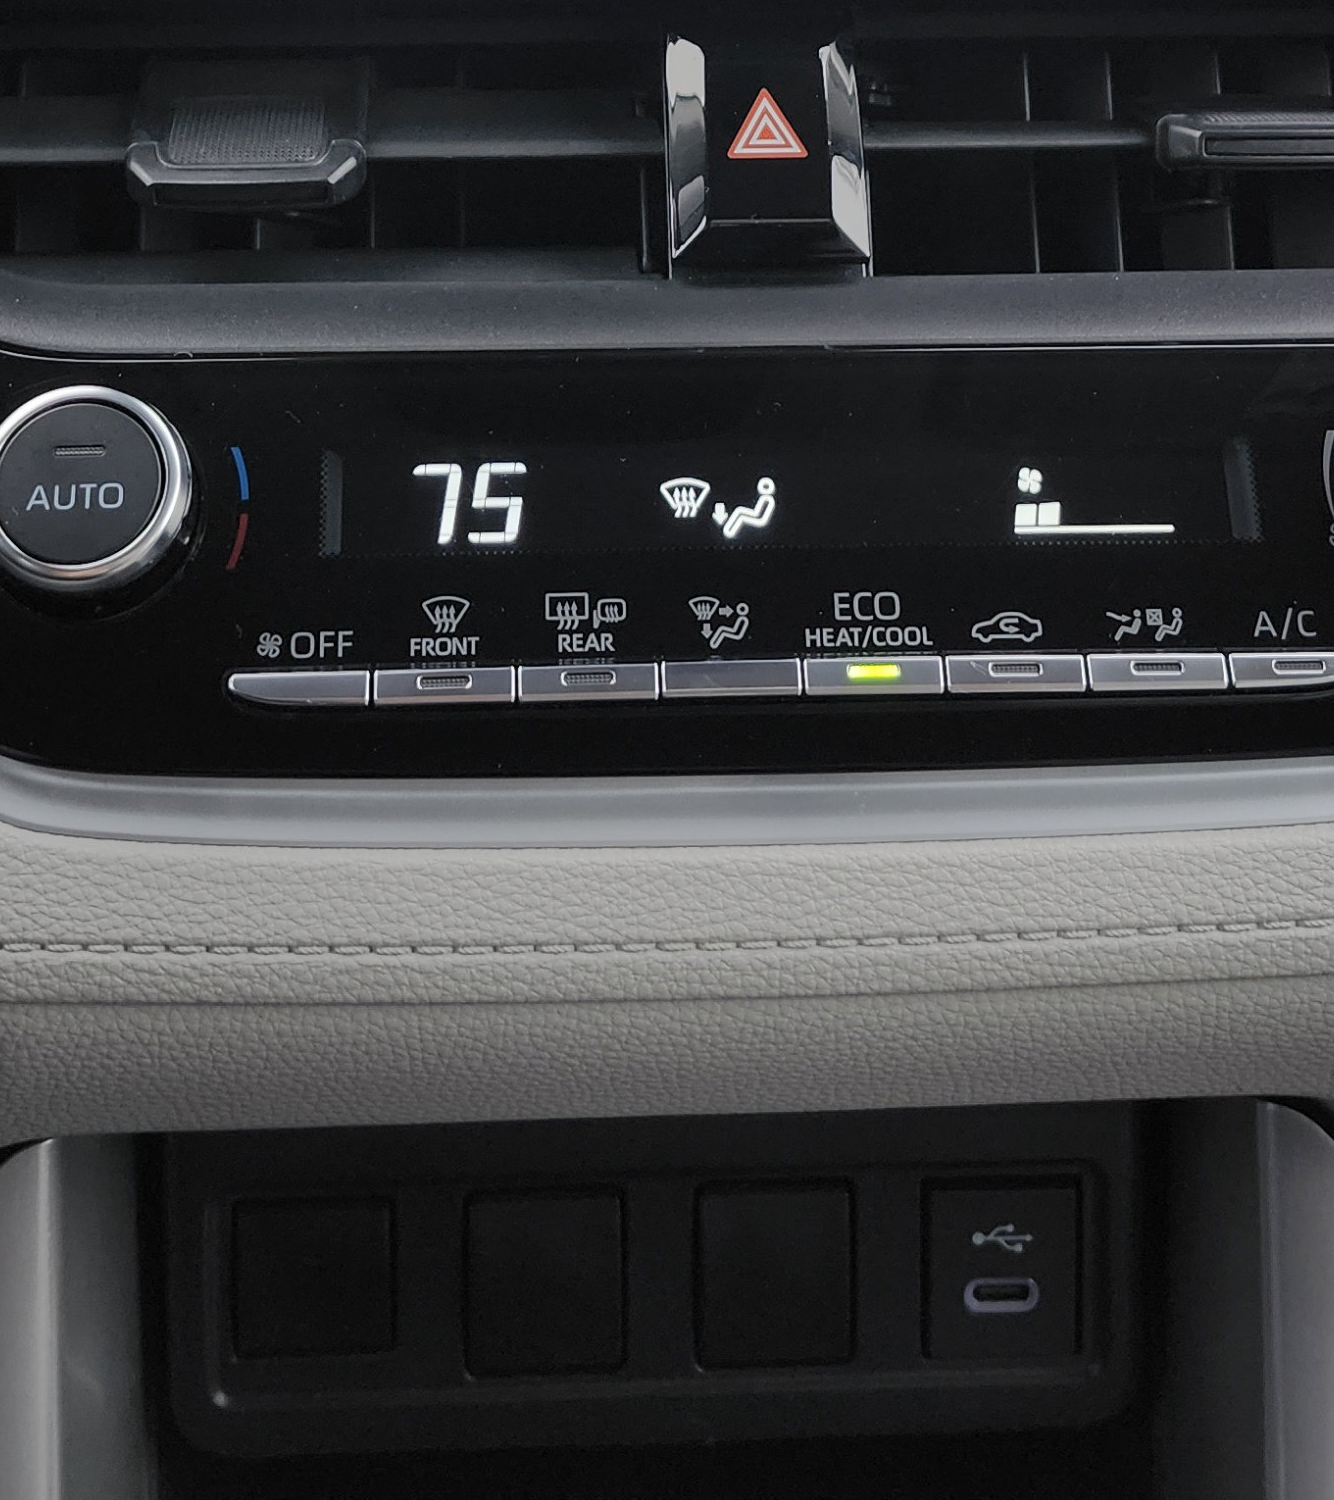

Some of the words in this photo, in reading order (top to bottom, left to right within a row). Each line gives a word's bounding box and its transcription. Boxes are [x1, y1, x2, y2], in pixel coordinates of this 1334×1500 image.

[26, 481, 124, 511] AUTO
[412, 461, 527, 545] 75
[833, 592, 901, 621] ECO
[805, 625, 934, 648] HEAT/COOL
[1254, 607, 1317, 640] A/C
[290, 630, 354, 659] OFF
[410, 636, 479, 657] FRONT
[558, 633, 615, 653] REAR
